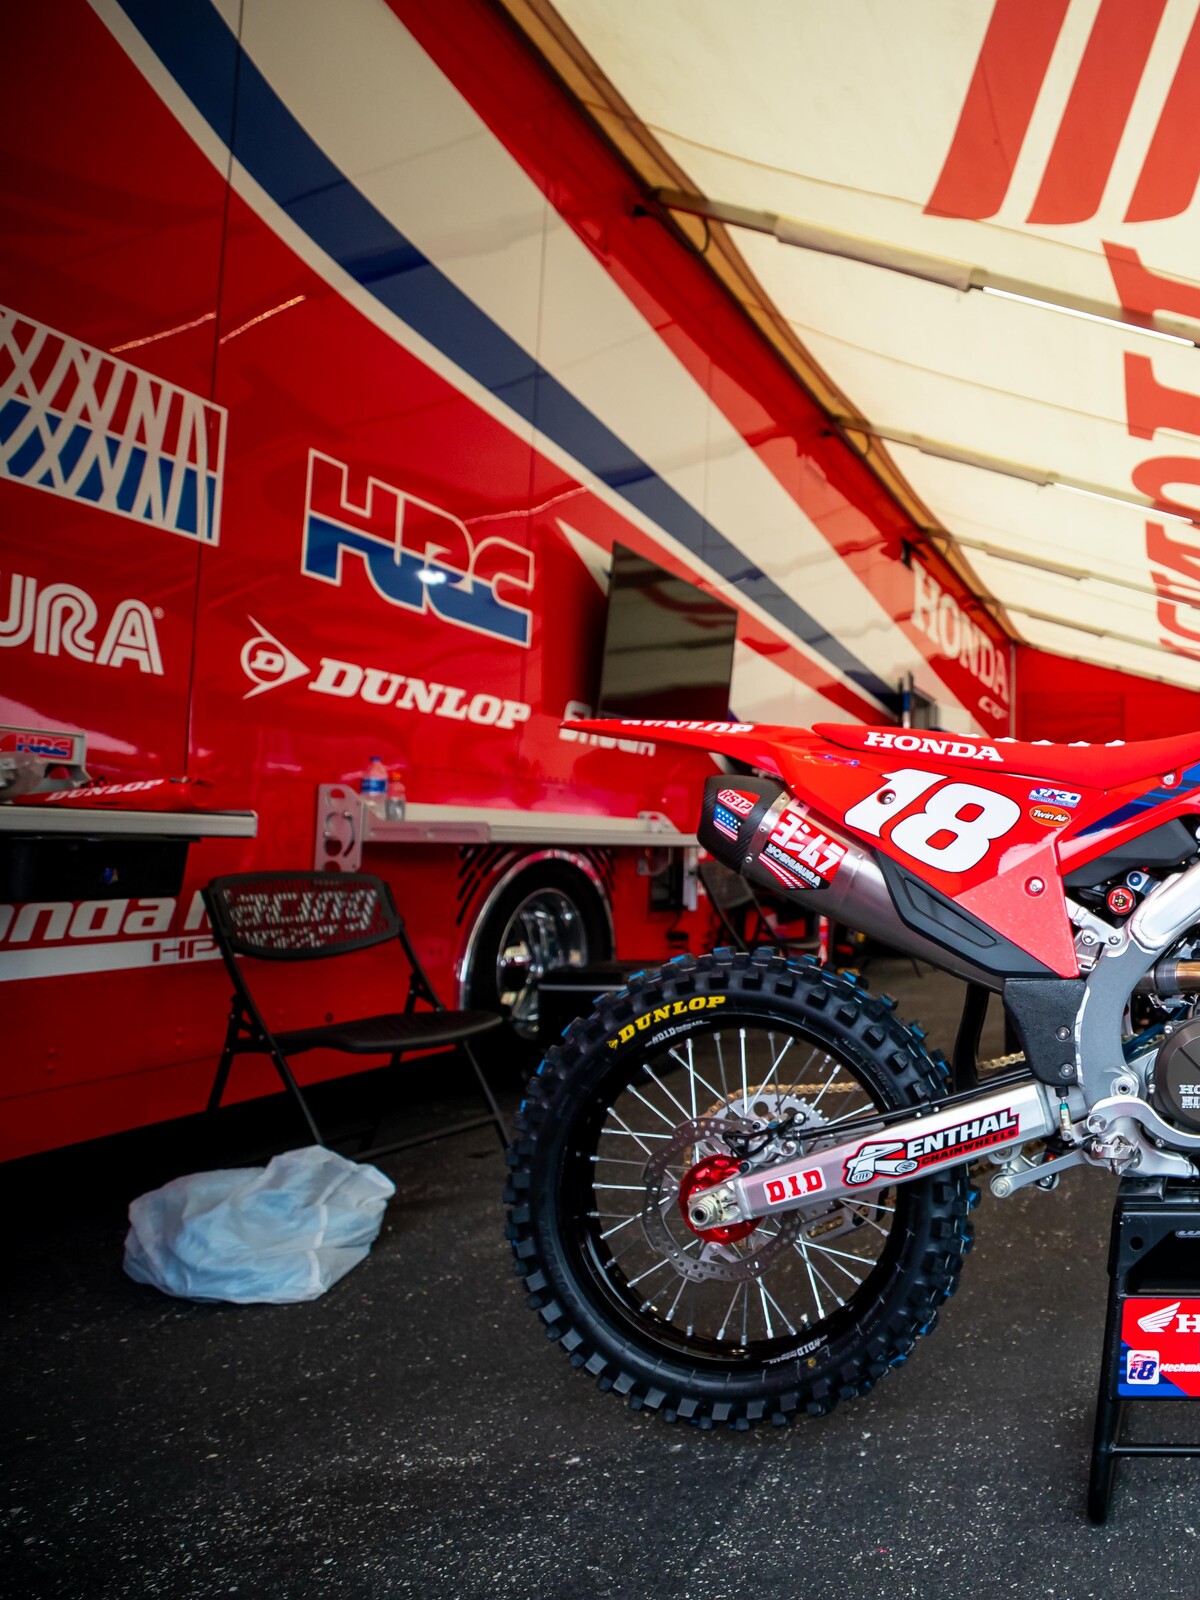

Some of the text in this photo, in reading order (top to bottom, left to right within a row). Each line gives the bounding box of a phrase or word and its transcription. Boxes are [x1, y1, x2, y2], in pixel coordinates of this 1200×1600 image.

[301, 447, 535, 650] HRC
[308, 657, 531, 730] DUNLOP
[864, 731, 1004, 762] HONDA
[45, 778, 165, 801] DUNLOP
[844, 768, 1021, 873] 18
[1033, 809, 1069, 822] Twin Air
[764, 843, 822, 887] YOSHIMURA
[771, 812, 847, 874] ヨシムラ
[0, 897, 177, 943] nda
[618, 996, 726, 1044] DUNLOP
[921, 1129, 1016, 1165] CHAINWHEELS
[766, 1170, 823, 1203] D.I.D
